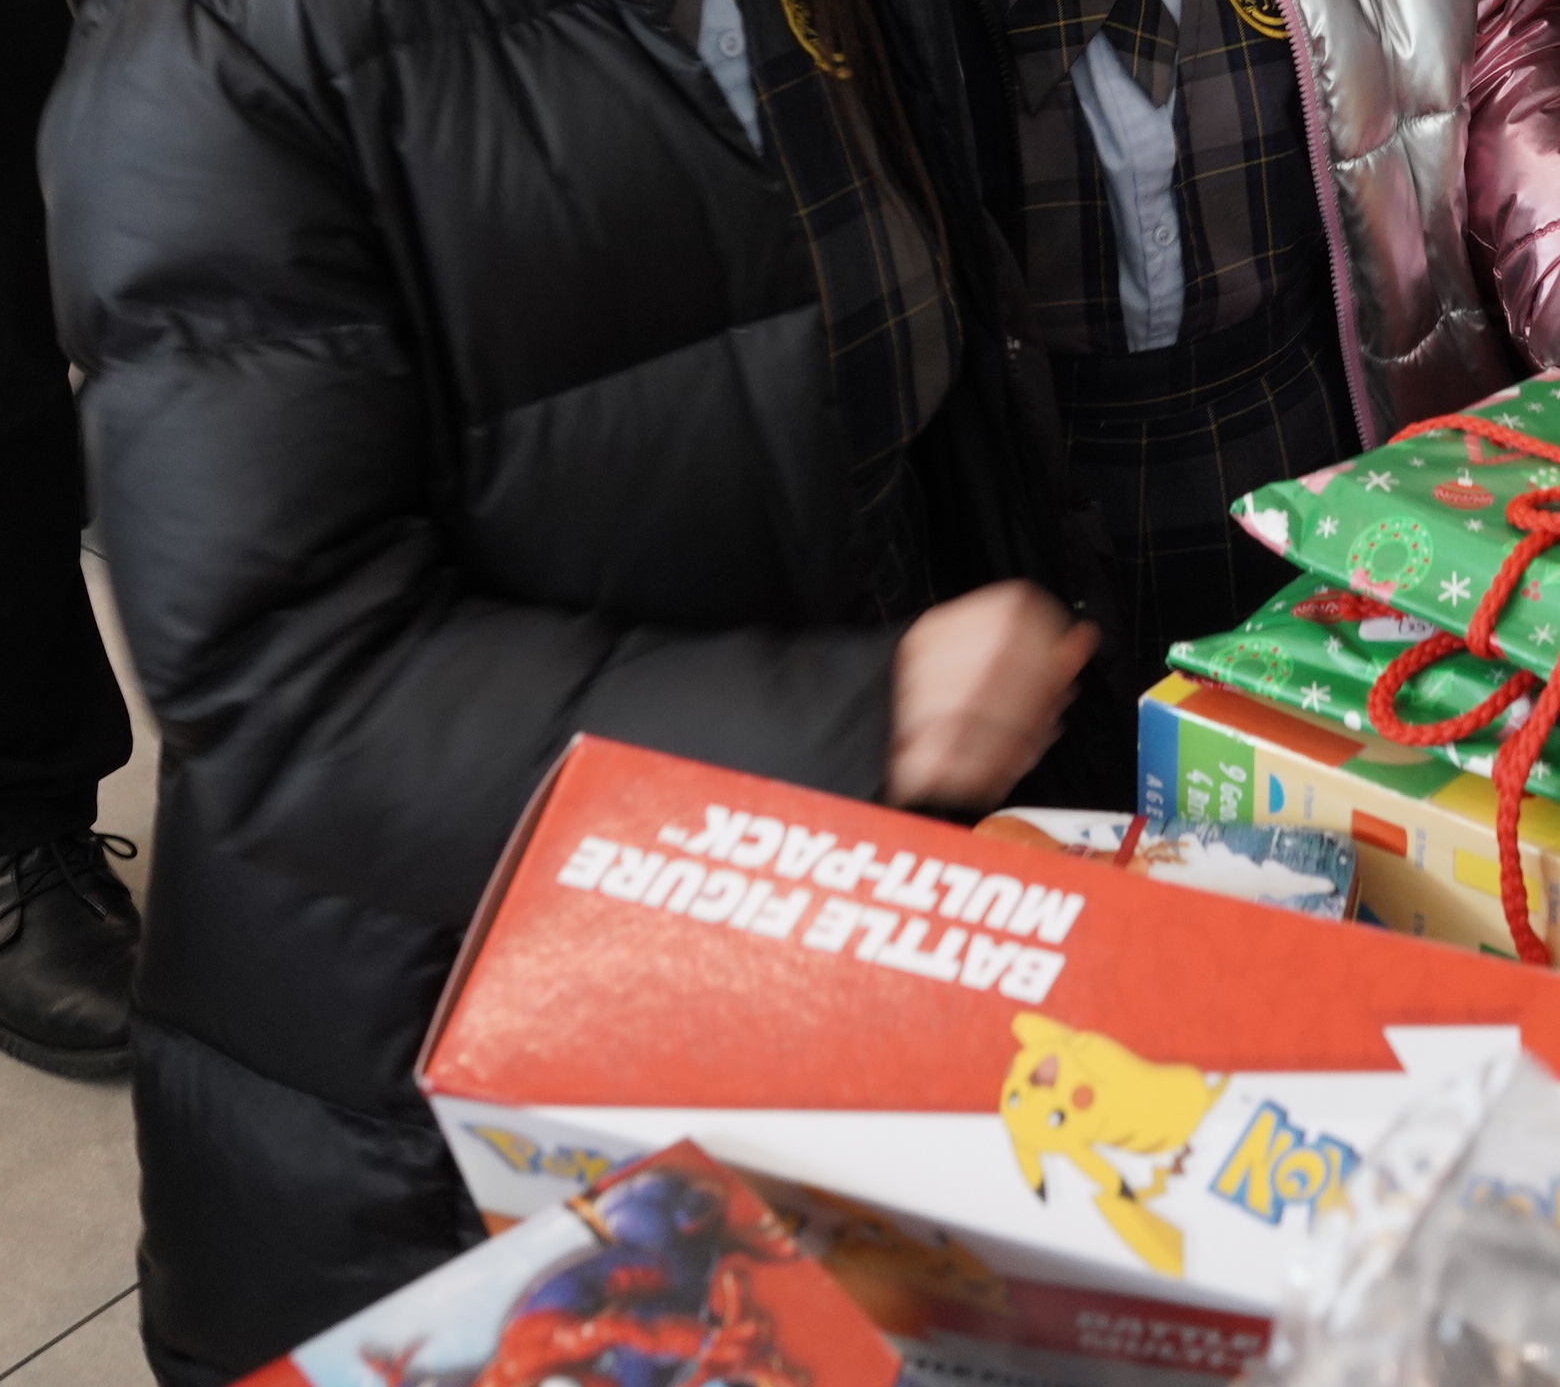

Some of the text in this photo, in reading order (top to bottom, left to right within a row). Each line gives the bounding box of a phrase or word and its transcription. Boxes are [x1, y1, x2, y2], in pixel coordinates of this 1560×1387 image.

[557, 836, 1069, 1003] BATTLE FIGURE
[703, 802, 1086, 944] MULTI-PACK
